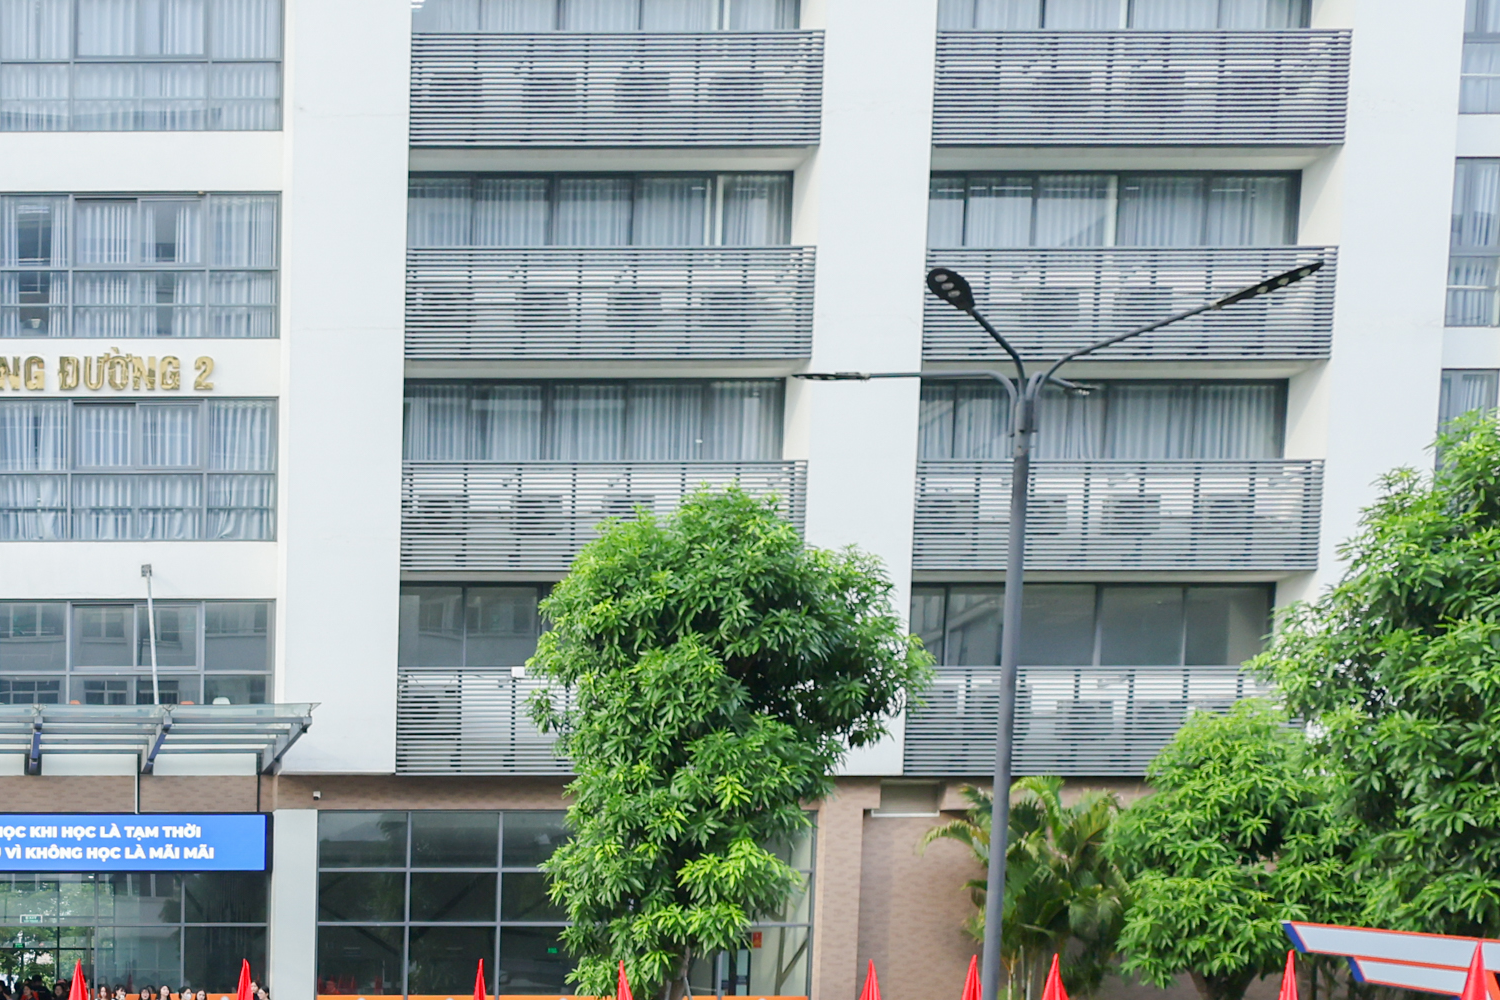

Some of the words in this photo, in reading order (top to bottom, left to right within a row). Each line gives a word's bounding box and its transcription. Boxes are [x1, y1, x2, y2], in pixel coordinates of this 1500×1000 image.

[57, 347, 181, 391] ĐƯỜNG
[193, 356, 214, 391] 2
[29, 825, 57, 838] KHI
[61, 825, 96, 841] HỌC
[100, 823, 121, 838] LÀ
[124, 825, 159, 841] TẠM
[162, 823, 201, 838] THỜI
[4, 844, 22, 859] VÌ
[25, 844, 83, 859] KHÔNG
[86, 847, 121, 862] HỌC
[124, 844, 146, 859] LÀ
[149, 844, 180, 859] MÃI
[183, 844, 214, 859] MÃI
